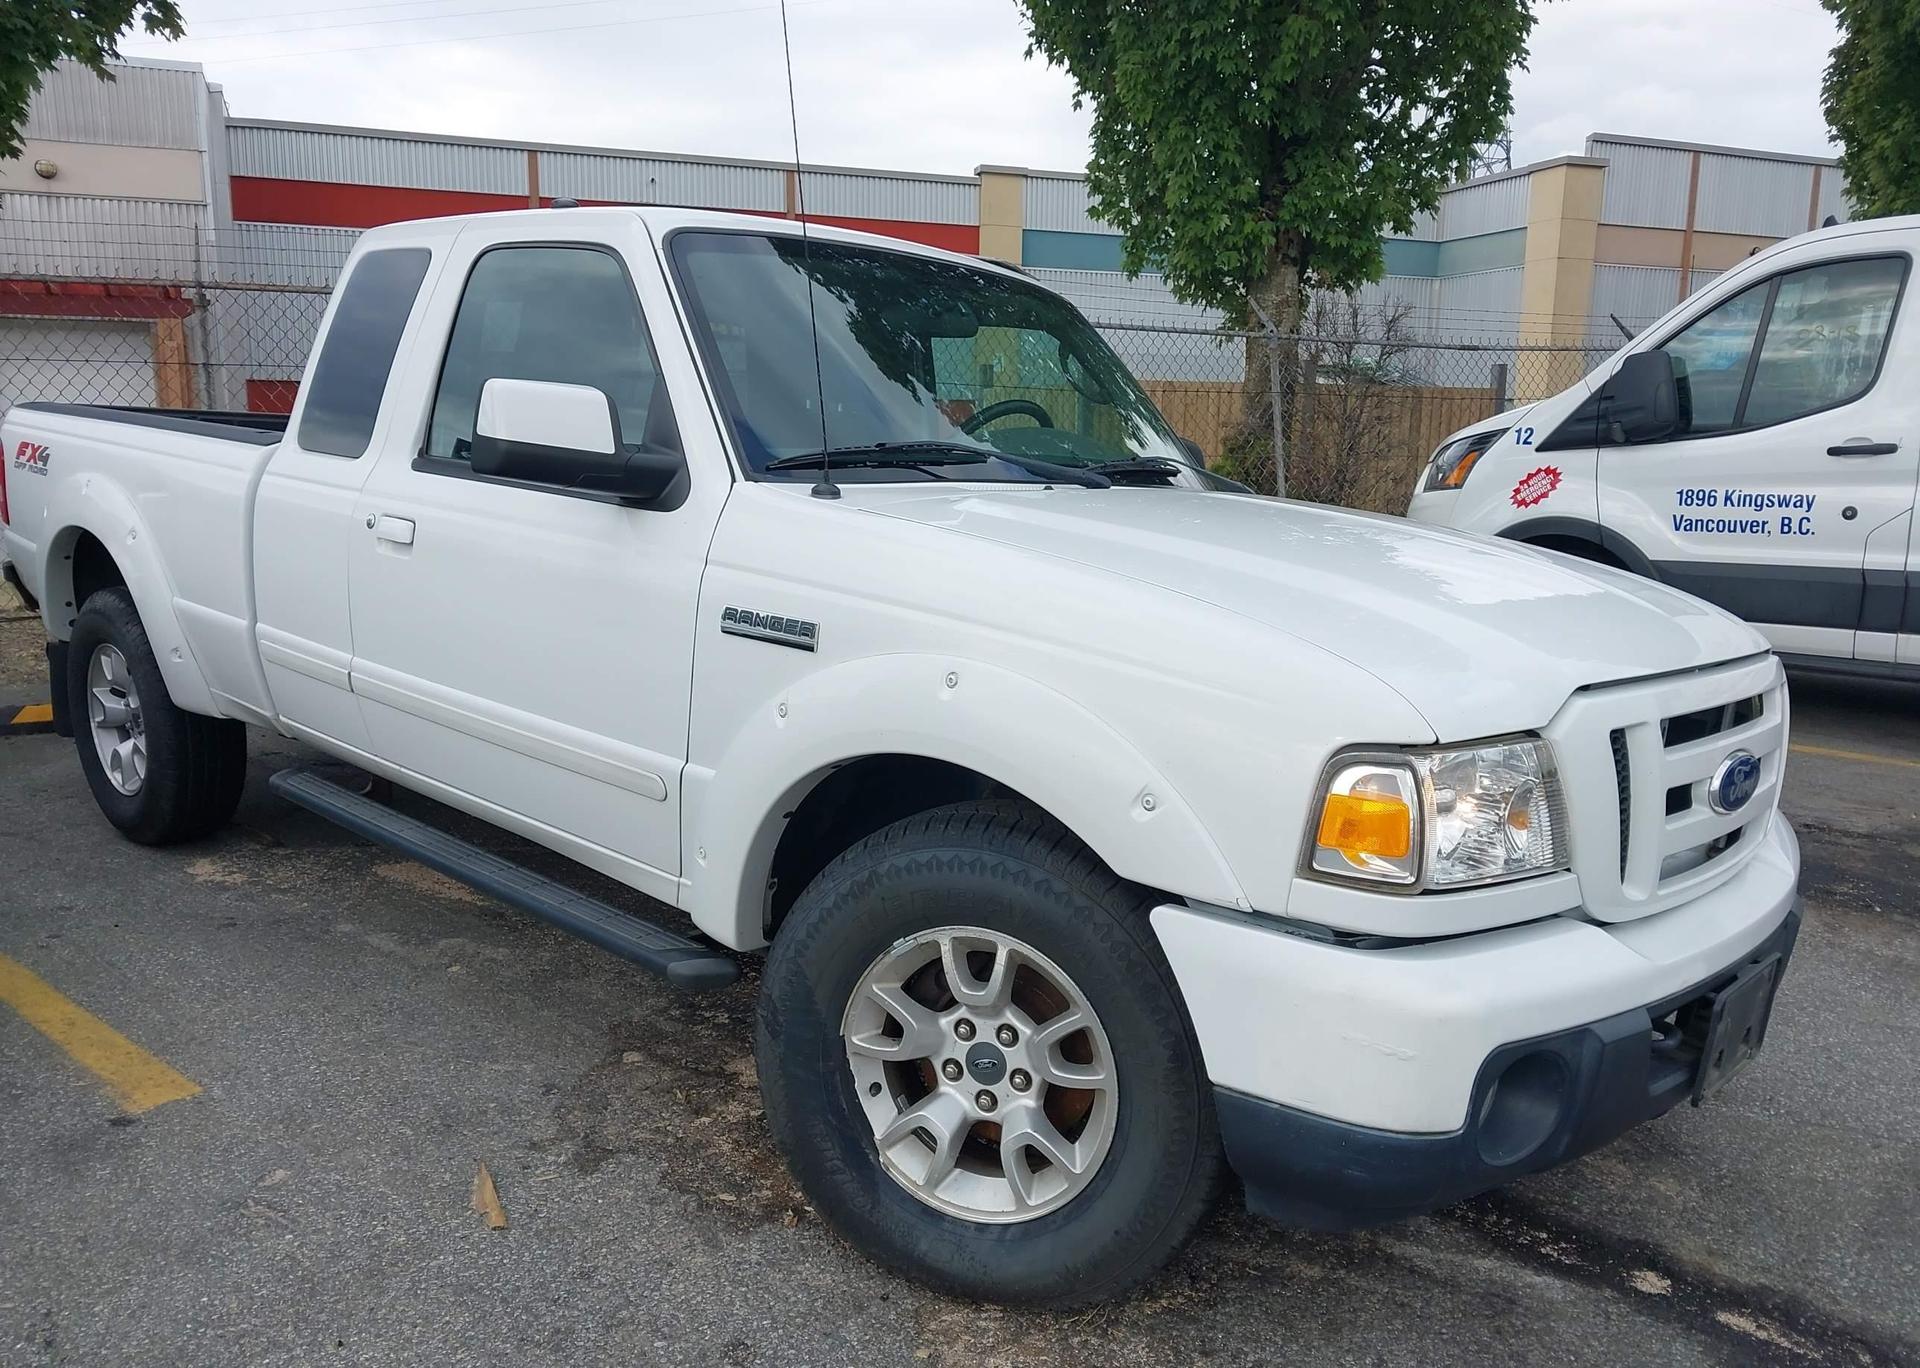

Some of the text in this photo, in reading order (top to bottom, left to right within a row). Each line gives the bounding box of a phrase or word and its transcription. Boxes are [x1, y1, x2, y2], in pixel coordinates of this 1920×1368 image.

[1515, 427, 1534, 445] 12
[15, 441, 50, 467] FX4
[1516, 474, 1555, 501] EMERGENCY
[1519, 471, 1547, 492] 24 HOUR
[1525, 483, 1552, 503] SERVICE
[1676, 488, 1816, 513] 1896 Kingsway
[1672, 514, 1816, 537] Vancouver, B.C.
[721, 606, 817, 639] RANGER
